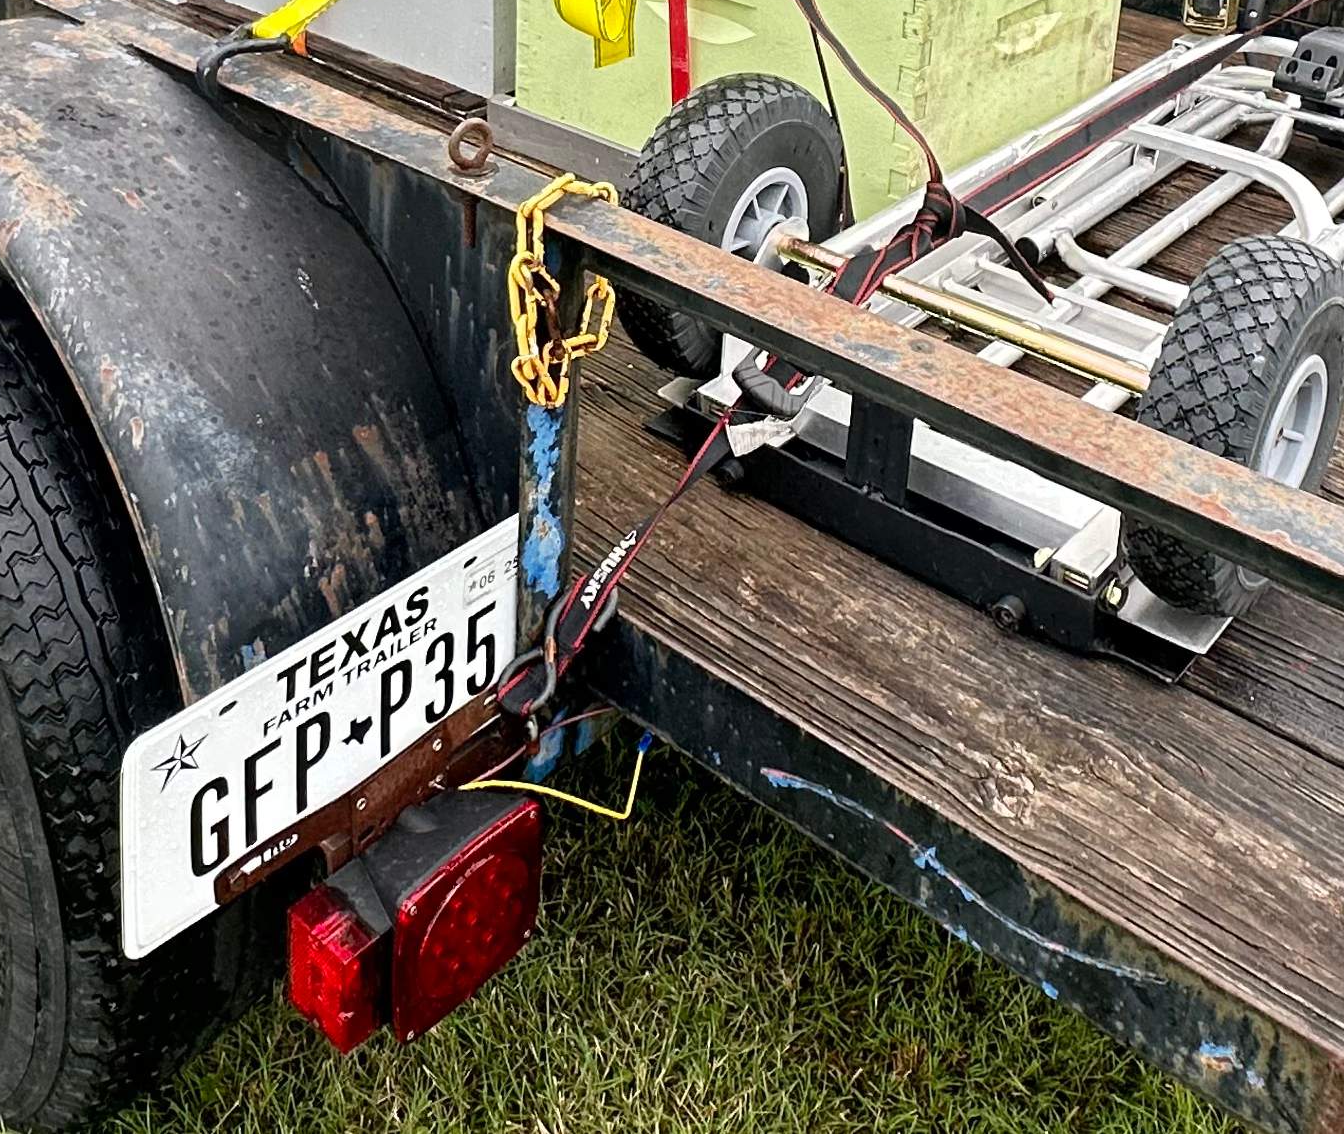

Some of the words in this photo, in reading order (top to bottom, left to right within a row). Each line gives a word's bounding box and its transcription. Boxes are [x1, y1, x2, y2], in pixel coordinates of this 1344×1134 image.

[579, 542, 629, 610] HUSKY
[262, 680, 335, 739] FARM
[342, 616, 439, 687] TRAILER
[276, 585, 431, 704] TEXAS
